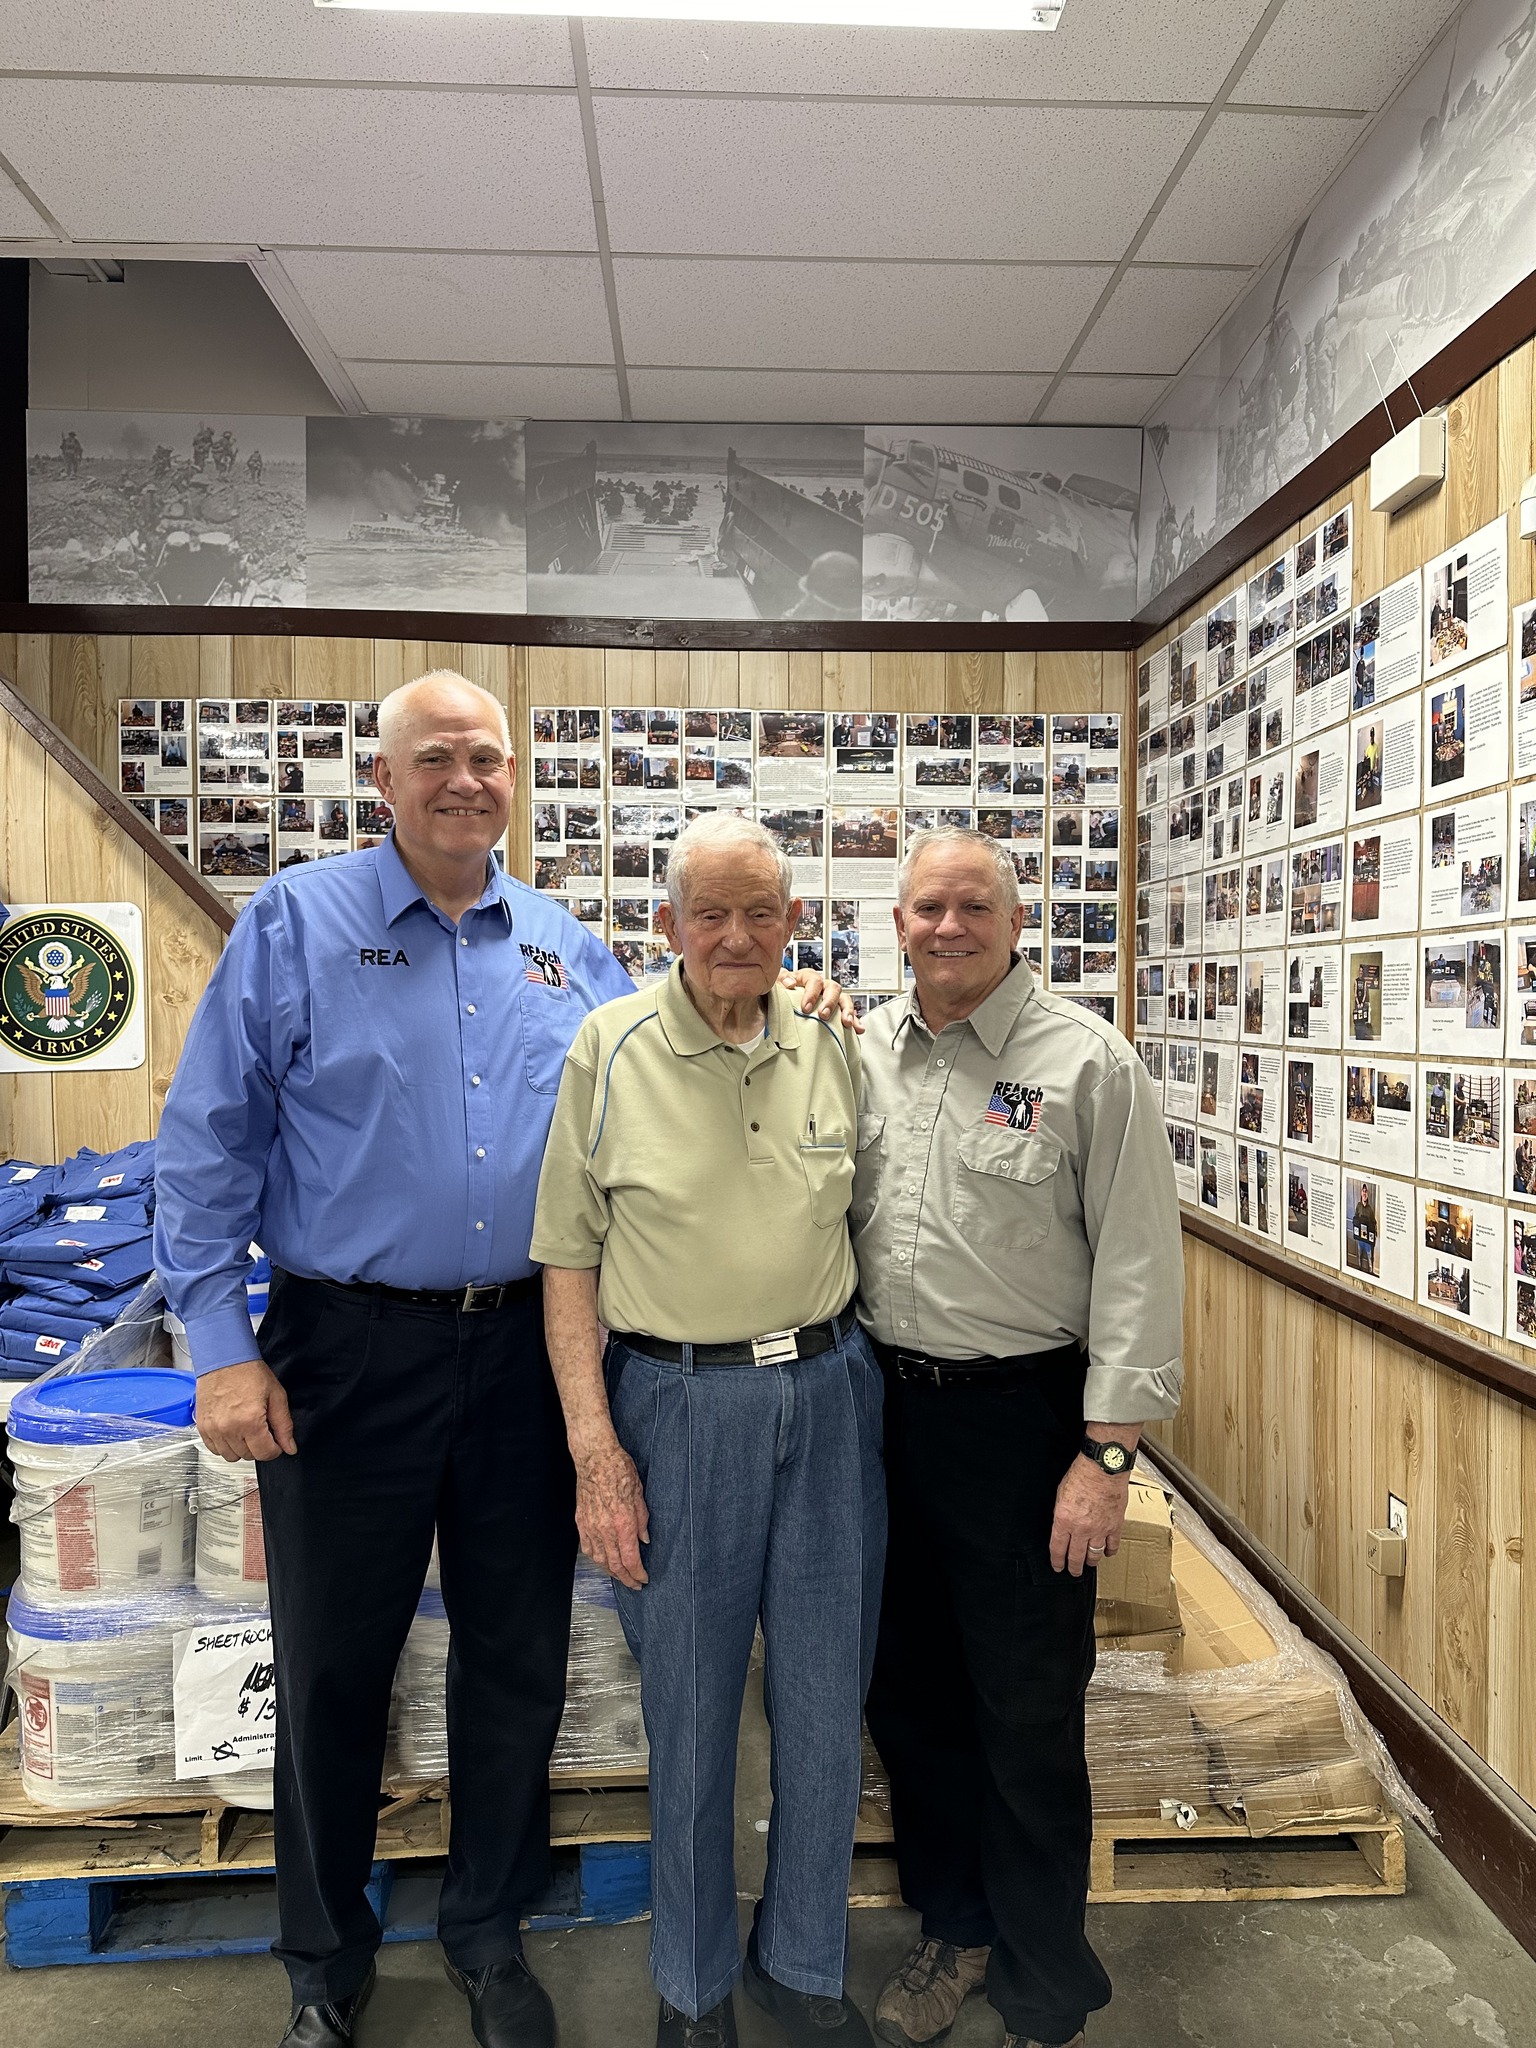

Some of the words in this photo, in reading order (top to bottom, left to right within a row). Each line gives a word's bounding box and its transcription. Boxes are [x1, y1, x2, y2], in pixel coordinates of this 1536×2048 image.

[0, 921, 56, 964] UNITED
[60, 921, 119, 964] STATES
[360, 949, 410, 967] REA
[31, 1034, 90, 1054] ARMY
[39, 1339, 61, 1349] 3M
[232, 1732, 276, 1743] Administra
[184, 1755, 203, 1763] Limit
